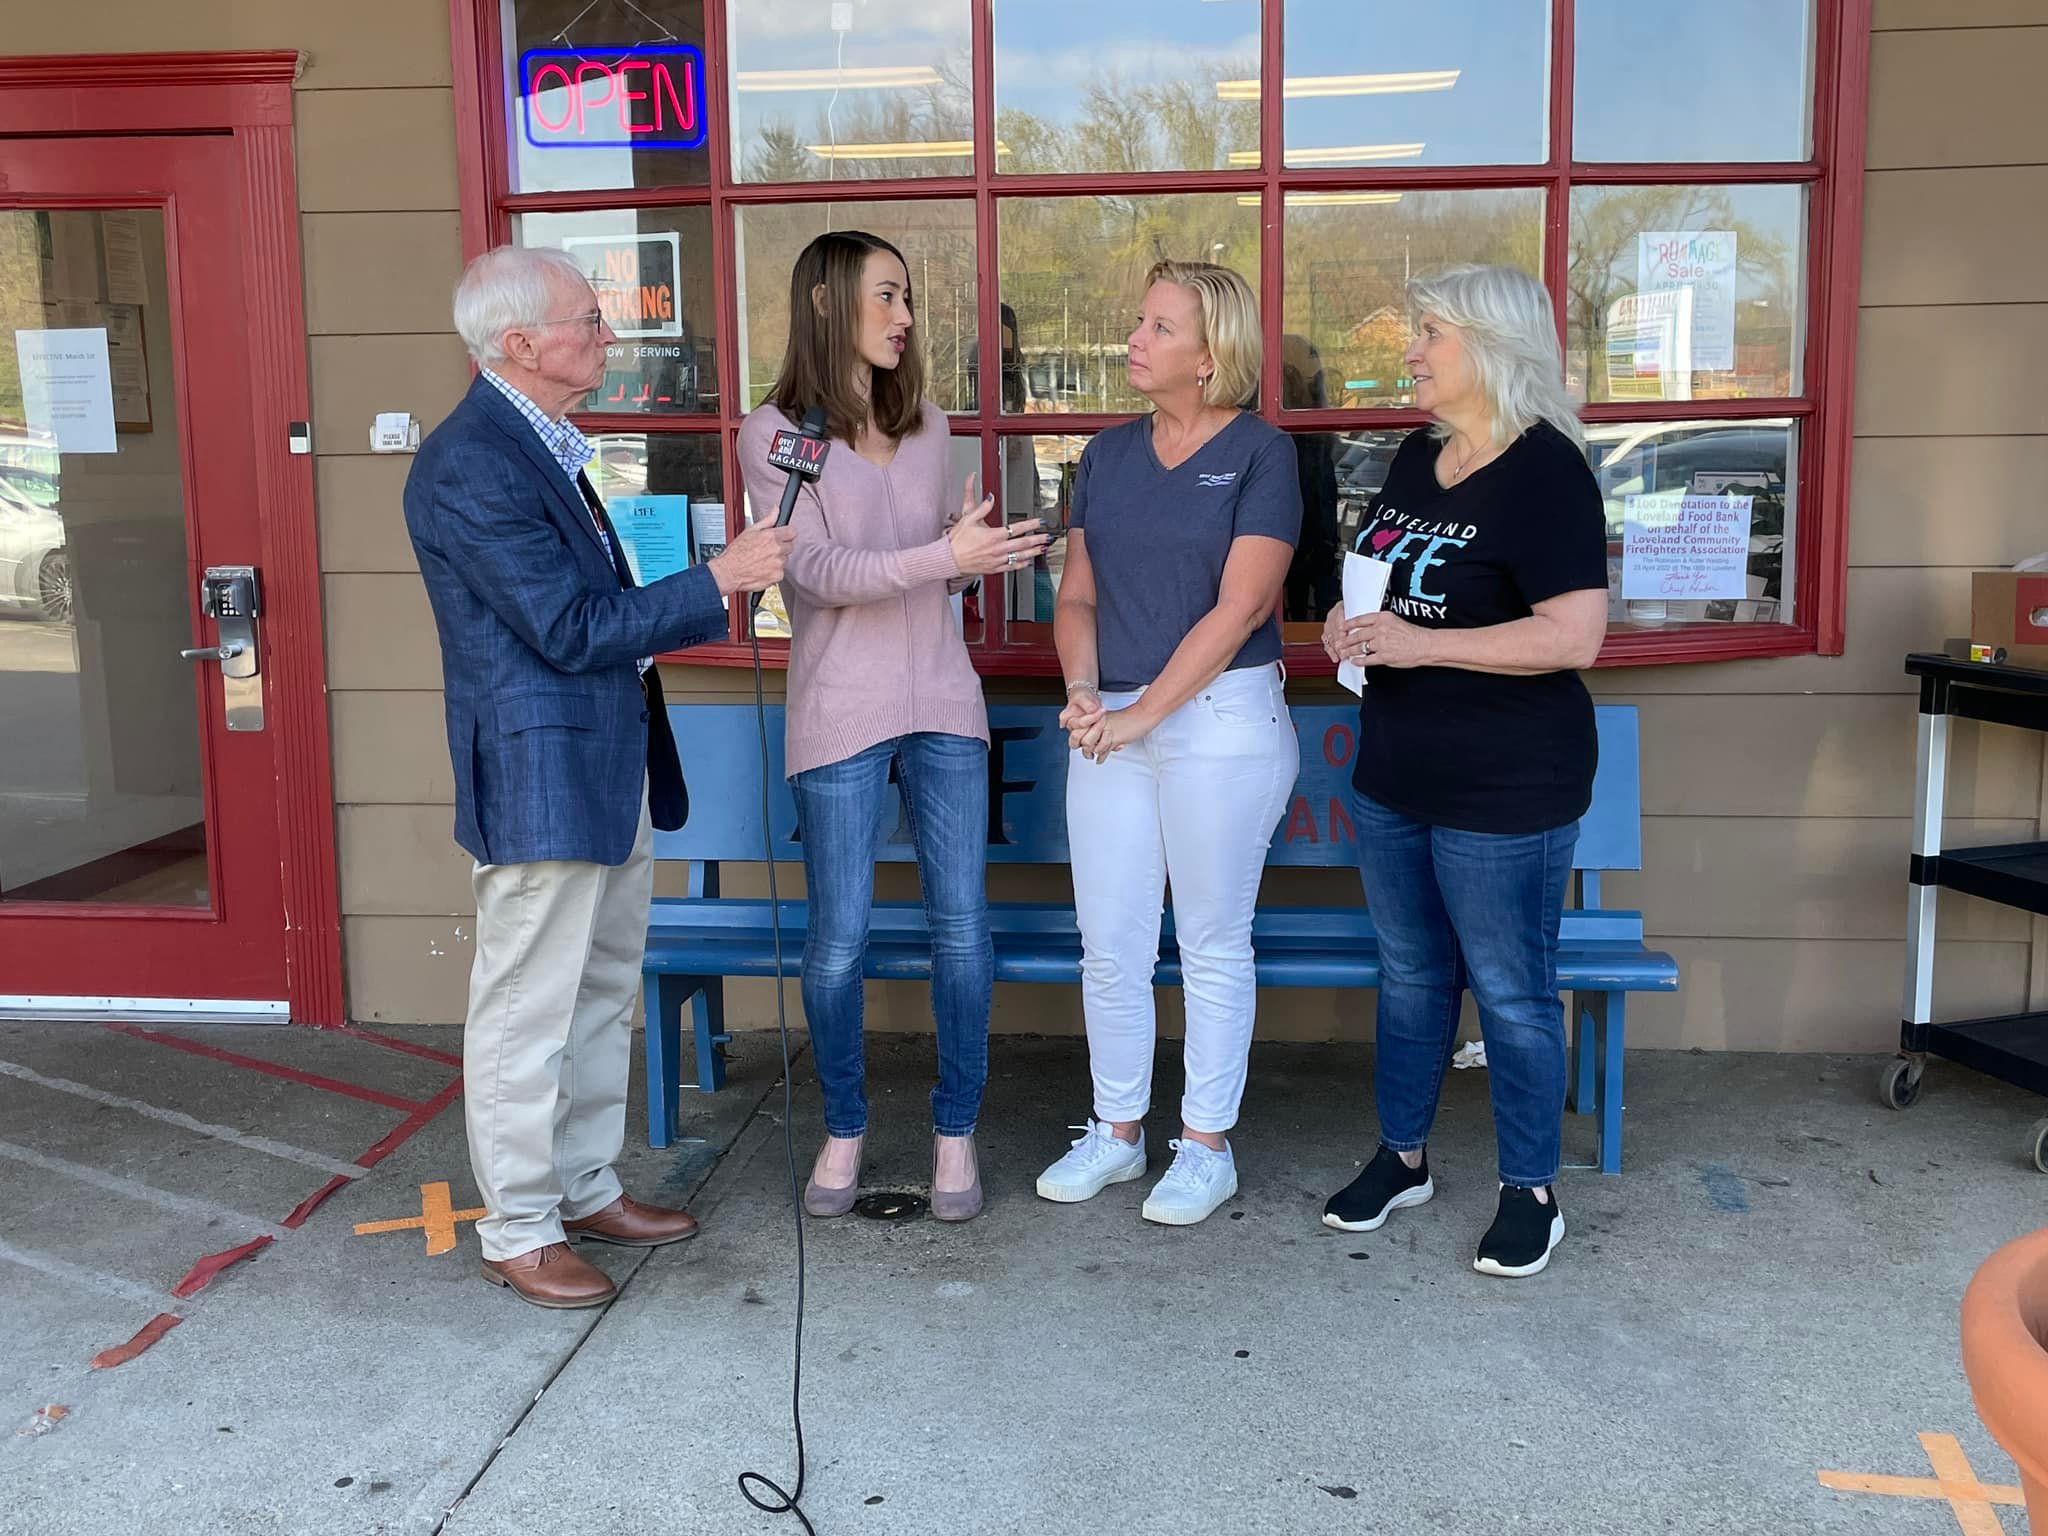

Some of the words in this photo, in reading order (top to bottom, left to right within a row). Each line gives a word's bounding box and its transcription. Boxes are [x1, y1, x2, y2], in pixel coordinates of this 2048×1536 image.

[531, 61, 695, 135] OPEN
[605, 248, 636, 282] NO
[1668, 263, 1704, 278] Sale
[599, 285, 672, 320] OKING
[607, 347, 624, 357] OW
[633, 347, 680, 357] SERVING
[800, 438, 825, 461] TV
[769, 453, 821, 472] MAGAZINE
[1720, 500, 1730, 509] to
[1733, 500, 1749, 509] the
[634, 507, 656, 517] LIFE
[1637, 511, 1685, 521] Loveland
[1688, 511, 1713, 521] Food
[1716, 511, 1740, 521] Bank
[1376, 504, 1477, 540] LOVELAND
[1648, 525, 1661, 534] on
[1664, 523, 1697, 534] behalf
[1700, 524, 1711, 534] of
[1714, 525, 1729, 534] the
[1632, 535, 1680, 544] Loveland
[1683, 535, 1741, 546] Community
[1626, 545, 1687, 556] Firefighters
[1690, 545, 1746, 554] Association
